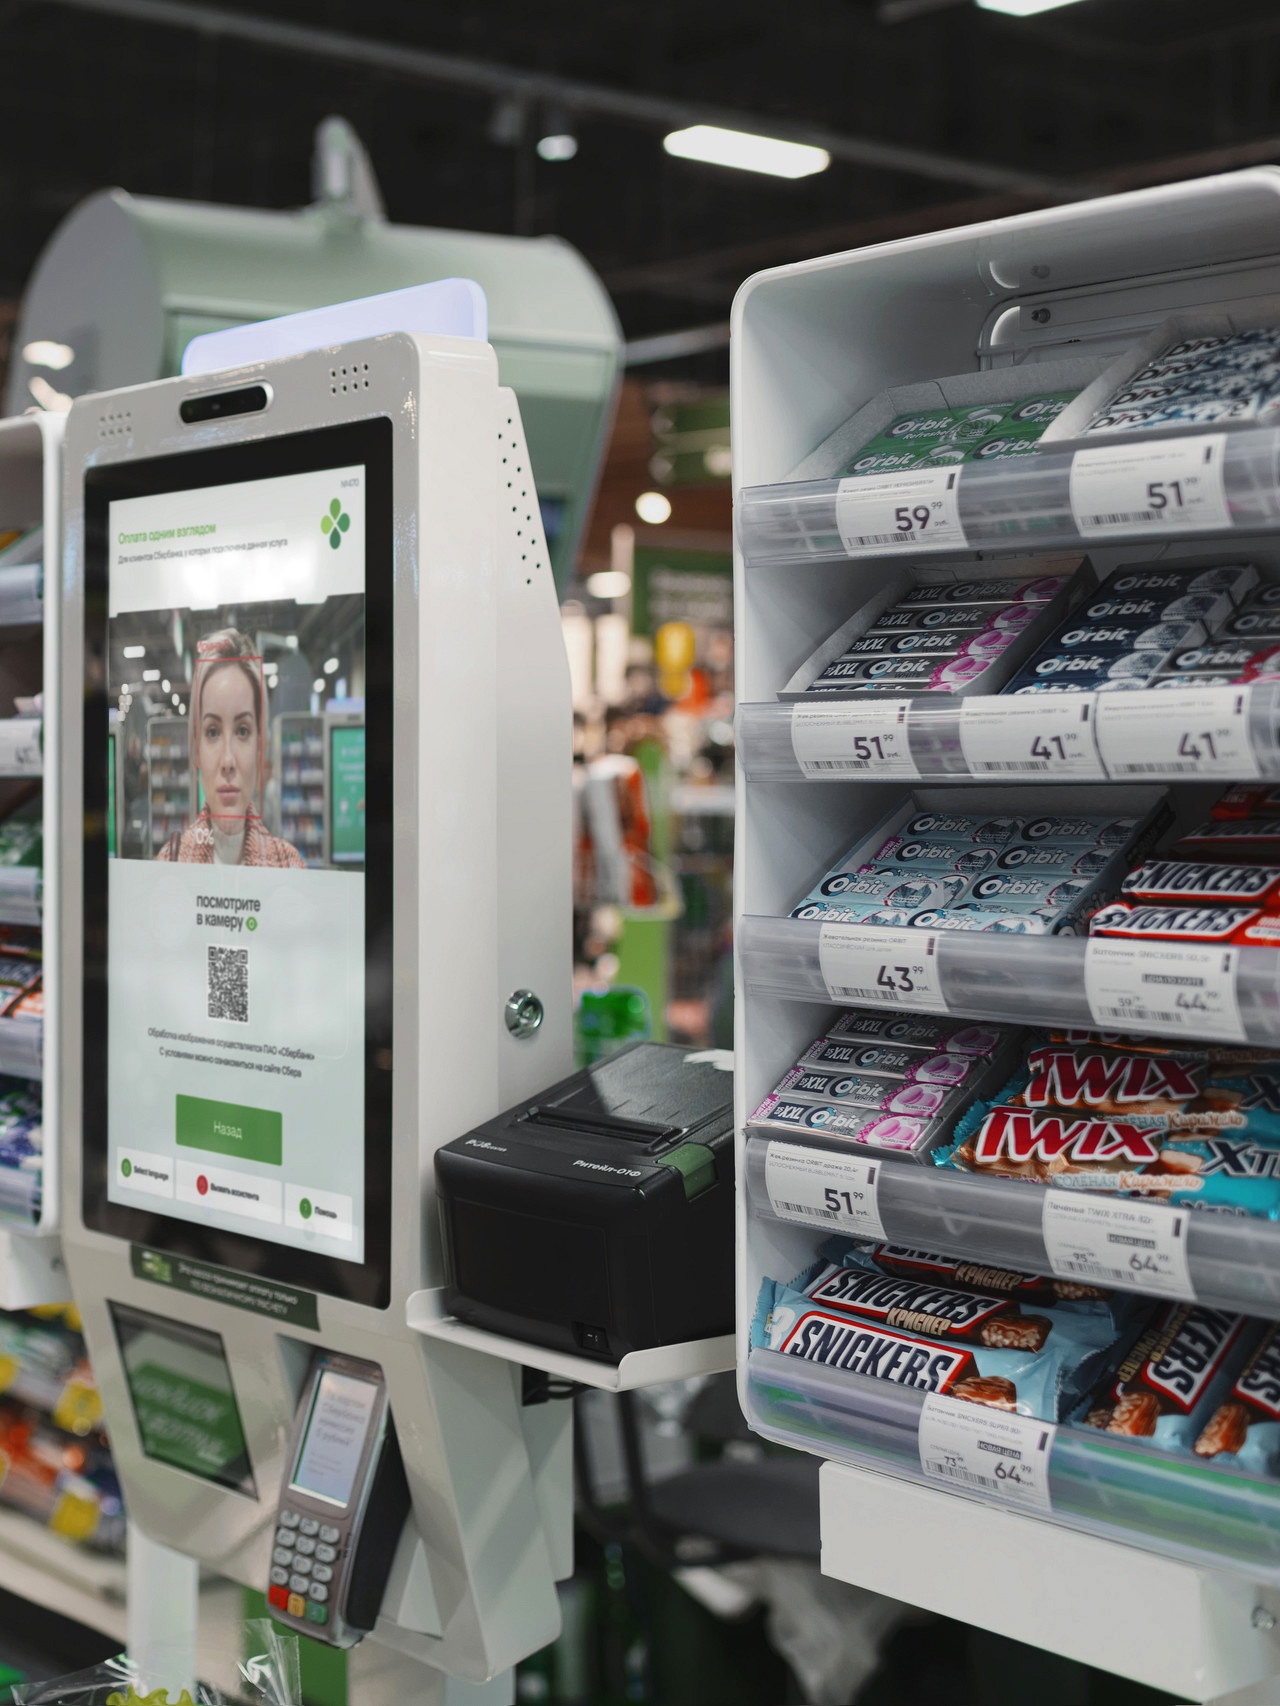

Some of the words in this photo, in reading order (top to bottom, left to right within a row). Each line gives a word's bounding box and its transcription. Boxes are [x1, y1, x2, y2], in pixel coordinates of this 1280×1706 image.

[1134, 358, 1205, 382] Dirol
[1113, 382, 1184, 406] Dirol
[1019, 399, 1071, 417] Orb
[892, 416, 953, 436] Orbit
[1090, 407, 1159, 430] Dirol
[981, 438, 1039, 455] Orbi
[854, 452, 915, 473] Orbit
[1147, 481, 1183, 510] 51
[895, 505, 930, 531] 59
[931, 501, 942, 510] 99
[118, 532, 147, 545] Оплата
[177, 524, 216, 538] взглядом
[1113, 576, 1183, 591] Orbit
[923, 609, 983, 626] Orbit
[1087, 601, 1158, 618] Orbit
[897, 633, 958, 650] Orbit
[1061, 628, 1131, 645] Orbit
[869, 658, 932, 675] Orbit
[1036, 655, 1107, 675] Orbit
[1176, 649, 1254, 667] Orbit
[854, 736, 884, 760] 51
[883, 734, 894, 742] 99
[1030, 736, 1066, 760] 41
[1179, 733, 1217, 760] 41
[914, 817, 971, 833] Orbit
[1029, 820, 1093, 837] Orbit
[902, 842, 955, 860] Orbit
[1005, 849, 1068, 866] Orbit
[827, 874, 885, 896] Orbit
[980, 878, 1044, 896] Orbit
[196, 895, 261, 913] посмотрите
[803, 905, 856, 922] Orbit
[912, 913, 977, 930] Orbit
[197, 914, 203, 925] в
[205, 914, 244, 932] камеру
[877, 965, 913, 992] 43
[912, 966, 923, 974] 99
[1176, 992, 1207, 1010] 44
[890, 1023, 938, 1038] Orbit
[861, 1048, 910, 1067] Orbit
[1026, 1048, 1207, 1107] TWIX
[834, 1079, 884, 1097] Orbit
[810, 1109, 860, 1129] Orbit
[214, 1121, 243, 1139] Назад
[976, 1105, 1165, 1163] TWIX
[572, 1159, 642, 1177] Ритейл-01Ф
[806, 1159, 823, 1167] ORBIT
[133, 1165, 147, 1176] Select
[148, 1169, 168, 1182] language
[1057, 1174, 1118, 1188] СОЛЁНАЯ
[825, 1188, 854, 1215] 51
[853, 1191, 864, 1200] 99
[1130, 1254, 1158, 1273] 64
[955, 1264, 1024, 1291] КРИСПЕР
[820, 1269, 997, 1325] SNICKERS
[886, 1306, 952, 1336] КРИСПЕР
[791, 1320, 956, 1395] SNICKERS
[978, 1440, 1002, 1453] НОВАЯ
[1003, 1446, 1021, 1460] ЦЕНА
[943, 1455, 957, 1467] 73
[994, 1461, 1021, 1484] 64
[1020, 1463, 1031, 1473] 99
